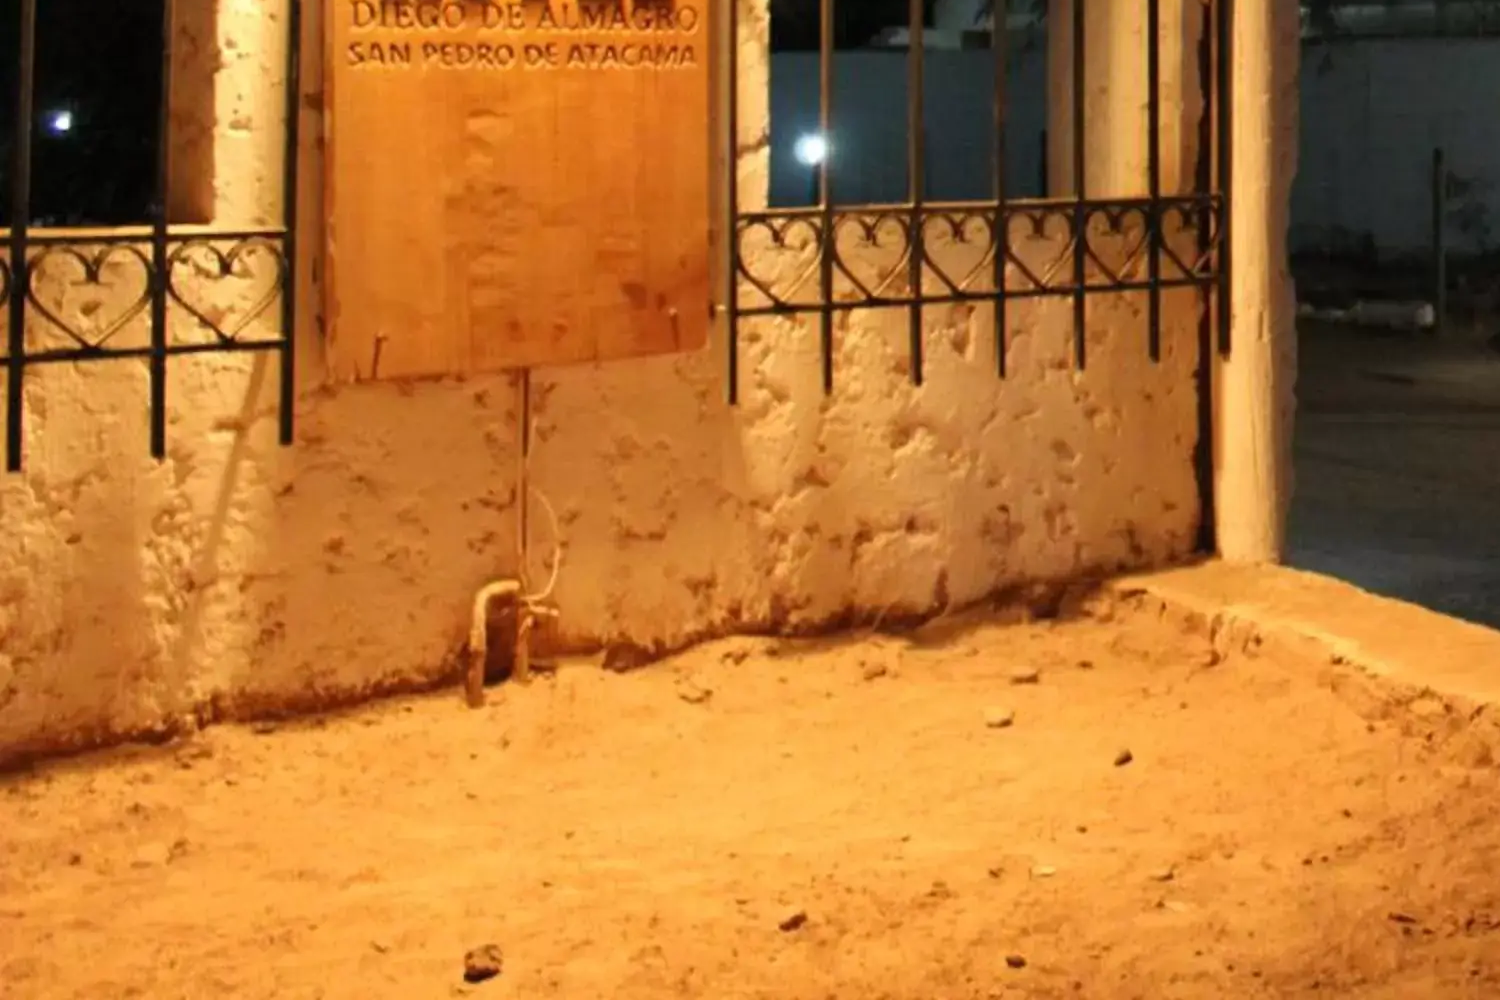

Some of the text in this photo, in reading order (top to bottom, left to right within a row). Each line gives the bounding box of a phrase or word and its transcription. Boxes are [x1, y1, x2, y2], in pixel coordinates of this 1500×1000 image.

[481, 1, 526, 30] DE
[536, 3, 698, 32] ALMAGRO
[348, 41, 696, 67] SAN PEDRO DE ATACAMA
